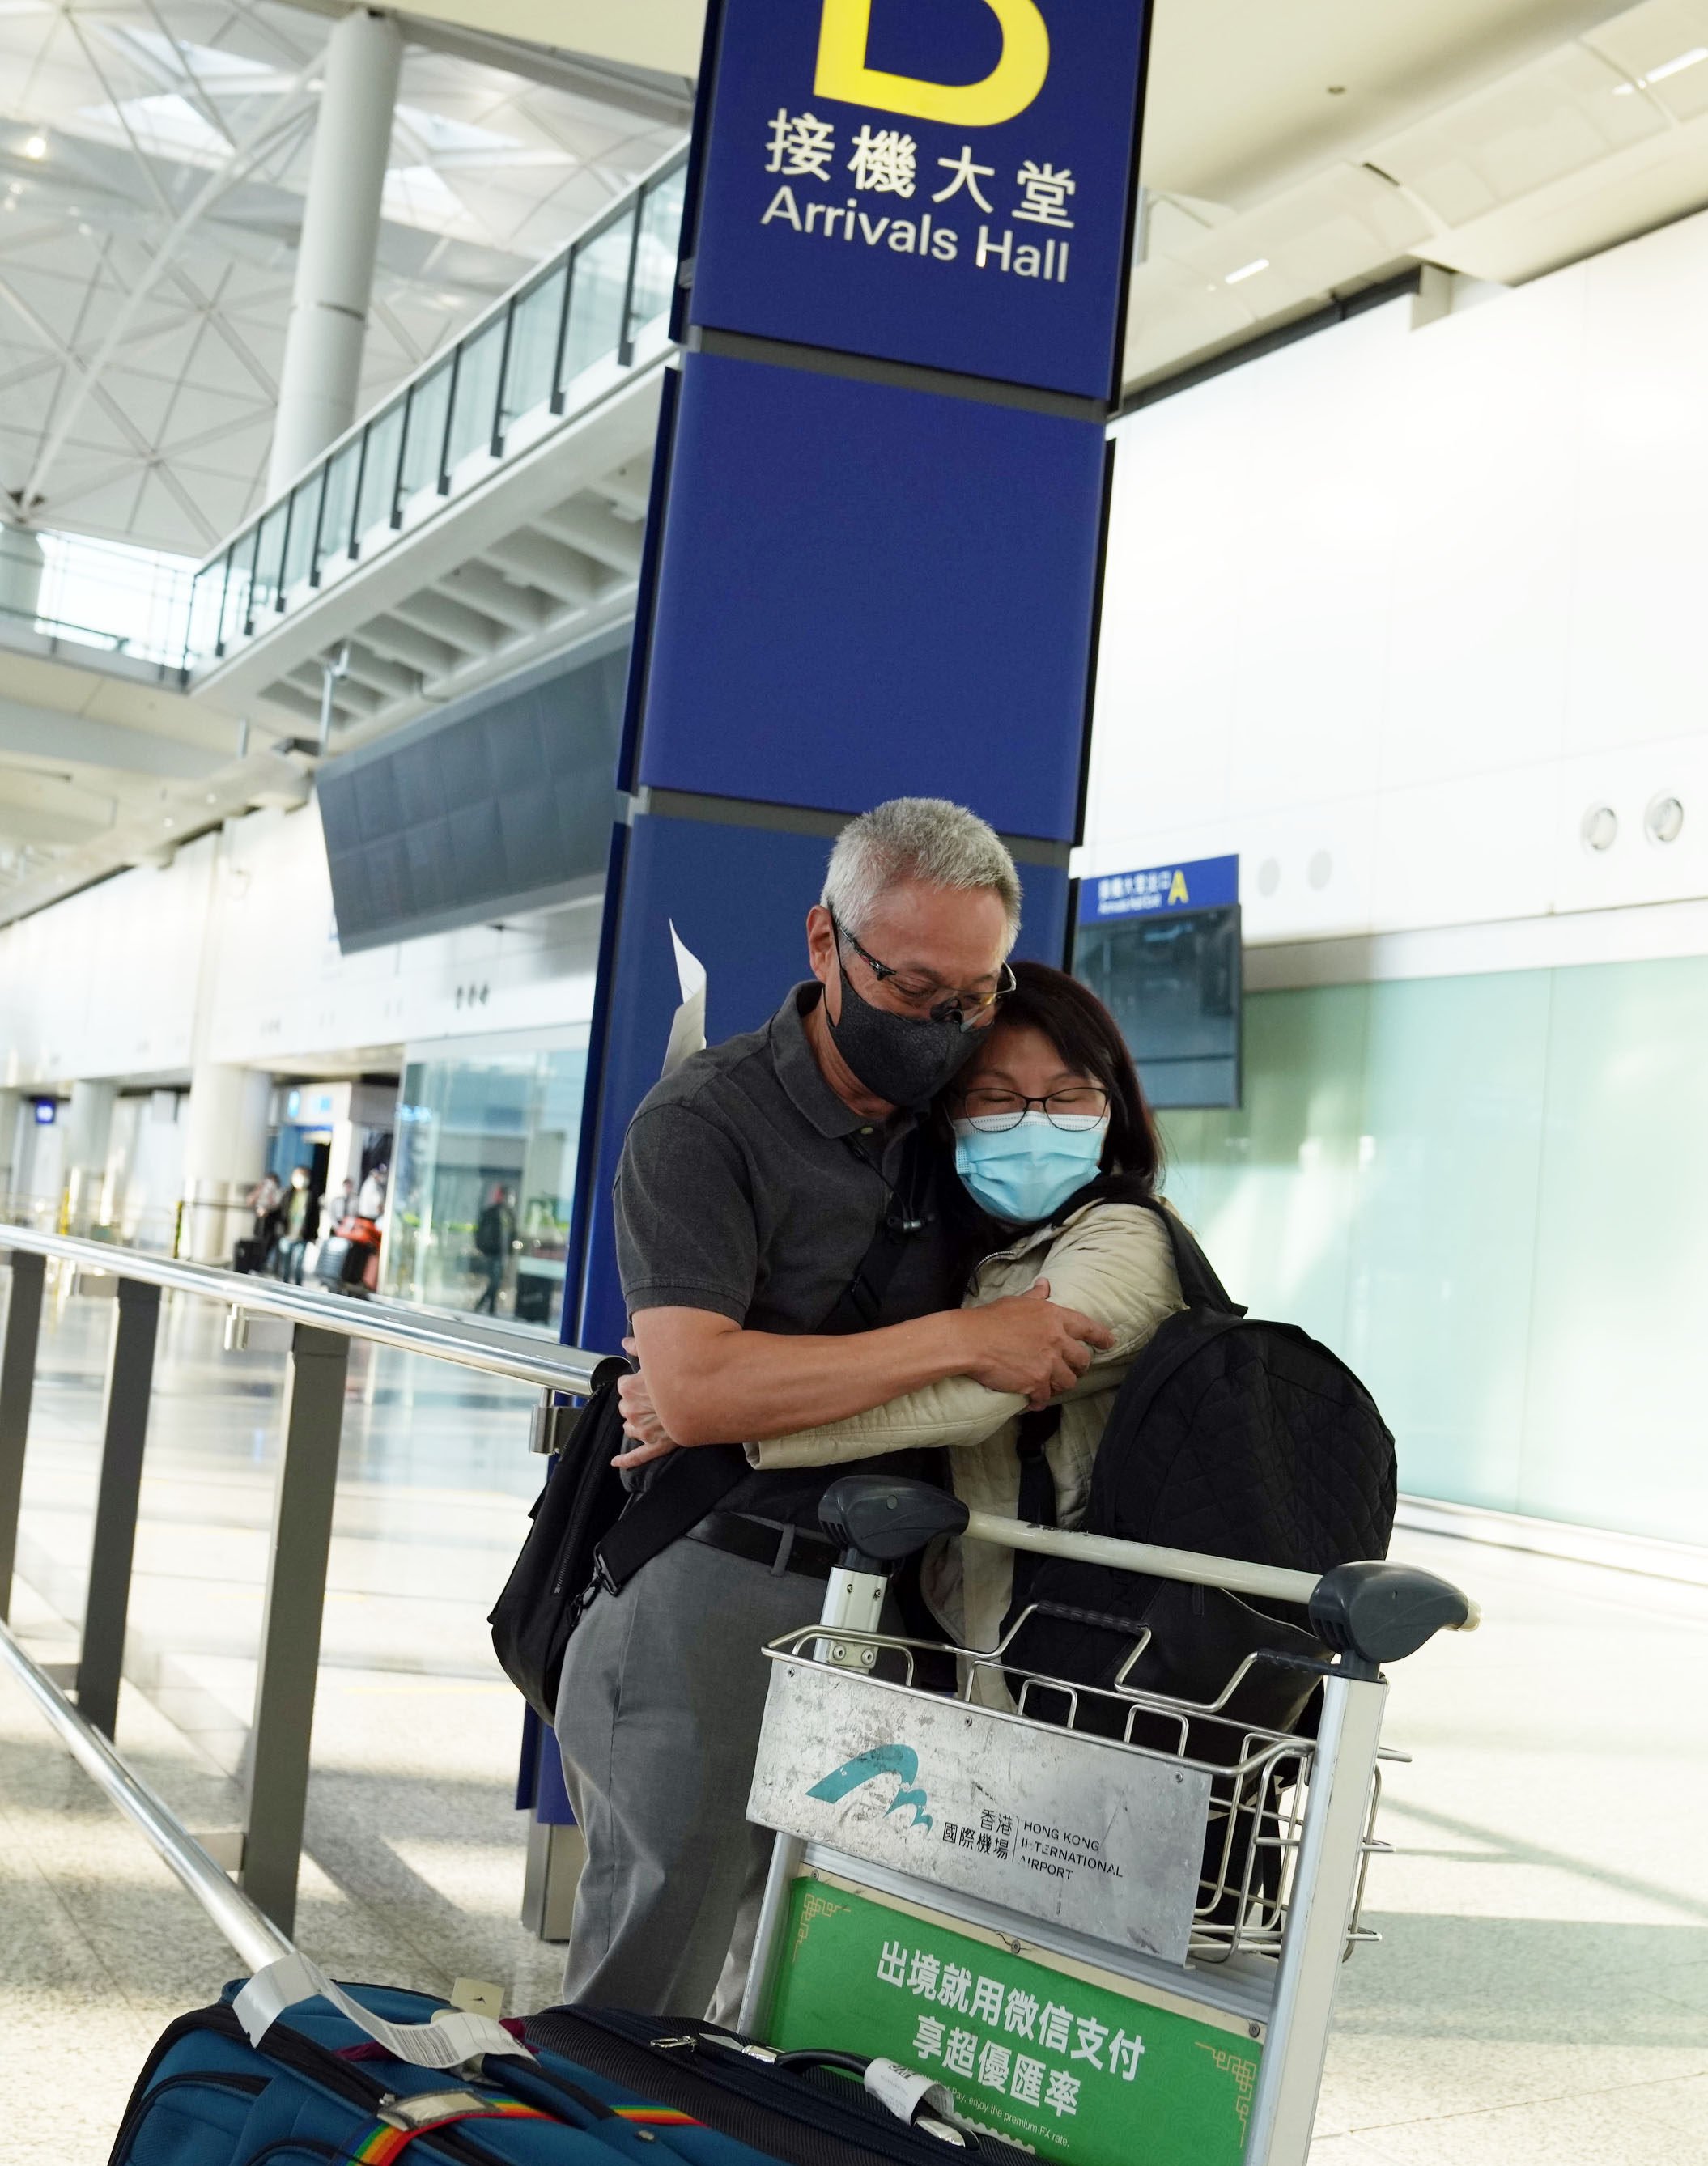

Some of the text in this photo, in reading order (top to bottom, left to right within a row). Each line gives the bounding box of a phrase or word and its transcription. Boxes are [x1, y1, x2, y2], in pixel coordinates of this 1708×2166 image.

[764, 108, 1076, 229] 接機大堂
[760, 185, 1069, 283] Arrivals Hall
[1167, 869, 1189, 906] A
[942, 1822, 1009, 1861] 國際機場
[980, 1808, 1013, 1837] 香港
[1023, 1820, 1101, 1853] HONG KONG
[877, 1940, 1145, 2081] 出境就用微信支付
[911, 2014, 1083, 2117] 享超優匯率
[969, 2097, 989, 2113] enjoy
[990, 2104, 1003, 2118] the
[1004, 2113, 1038, 2133] premium
[1039, 2126, 1052, 2138] FX
